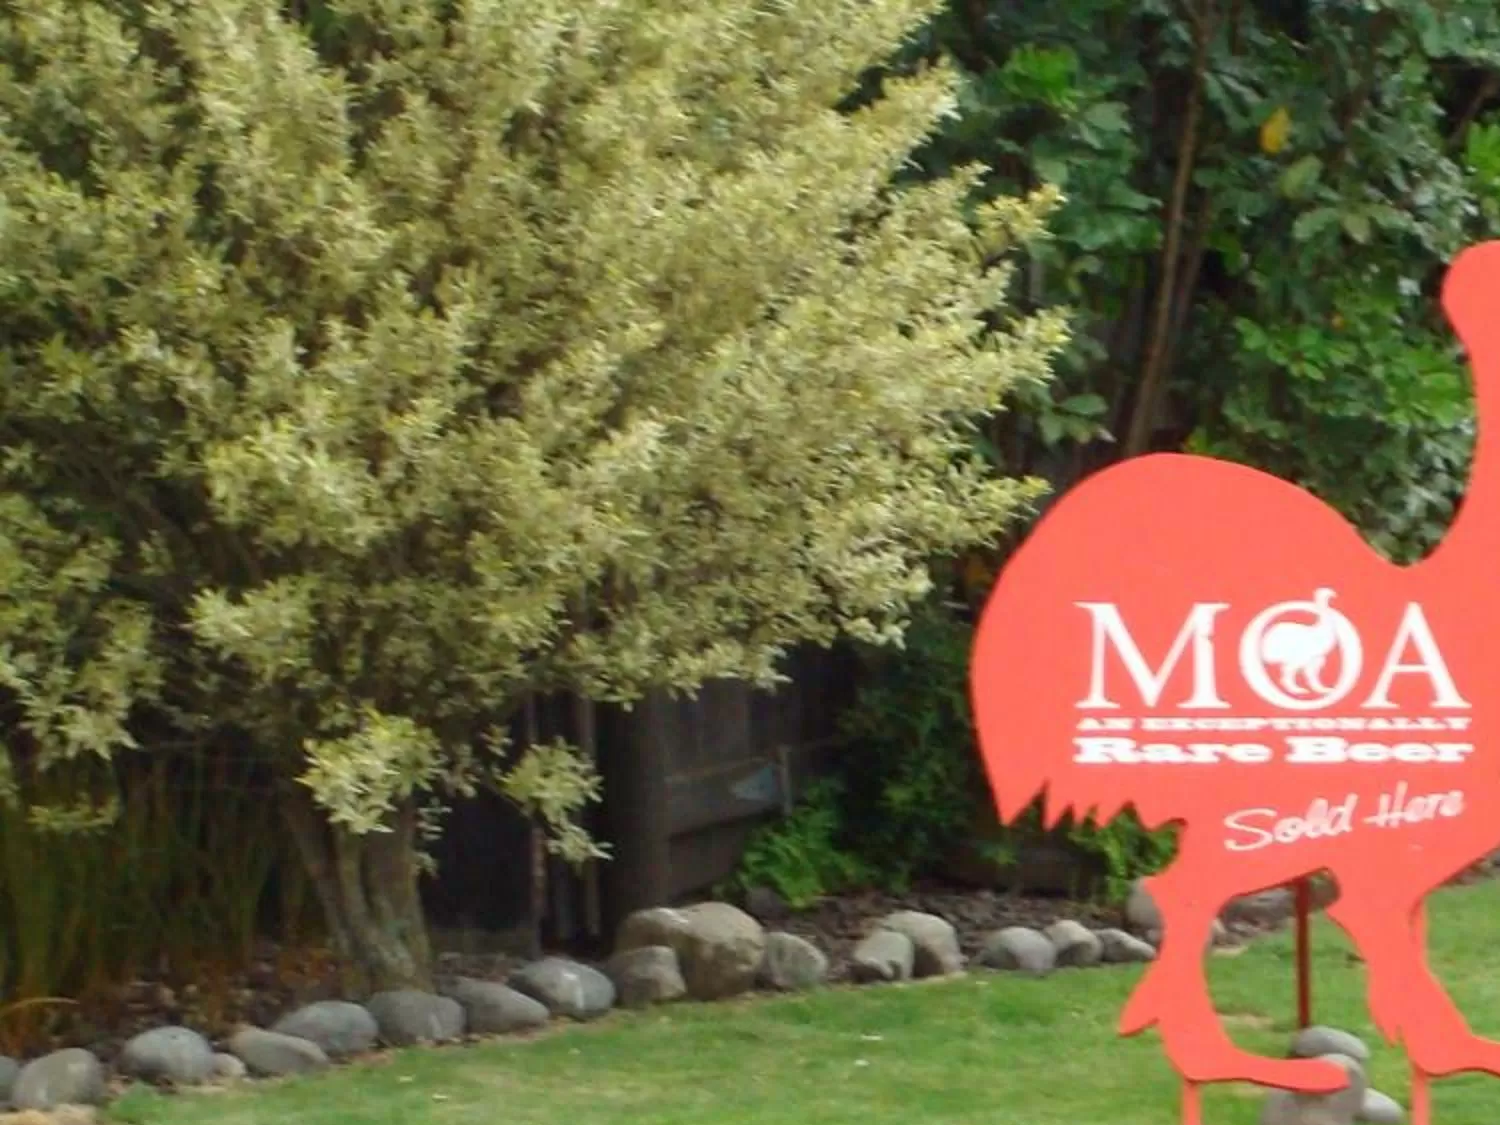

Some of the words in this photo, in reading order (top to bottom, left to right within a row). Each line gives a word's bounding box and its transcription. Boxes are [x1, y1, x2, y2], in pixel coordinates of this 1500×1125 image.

[1072, 600, 1472, 710] MOA
[1072, 736, 1274, 764] Rare
[1284, 736, 1476, 764] Beer
[1223, 793, 1359, 852] Sold
[1363, 780, 1465, 828] Here
